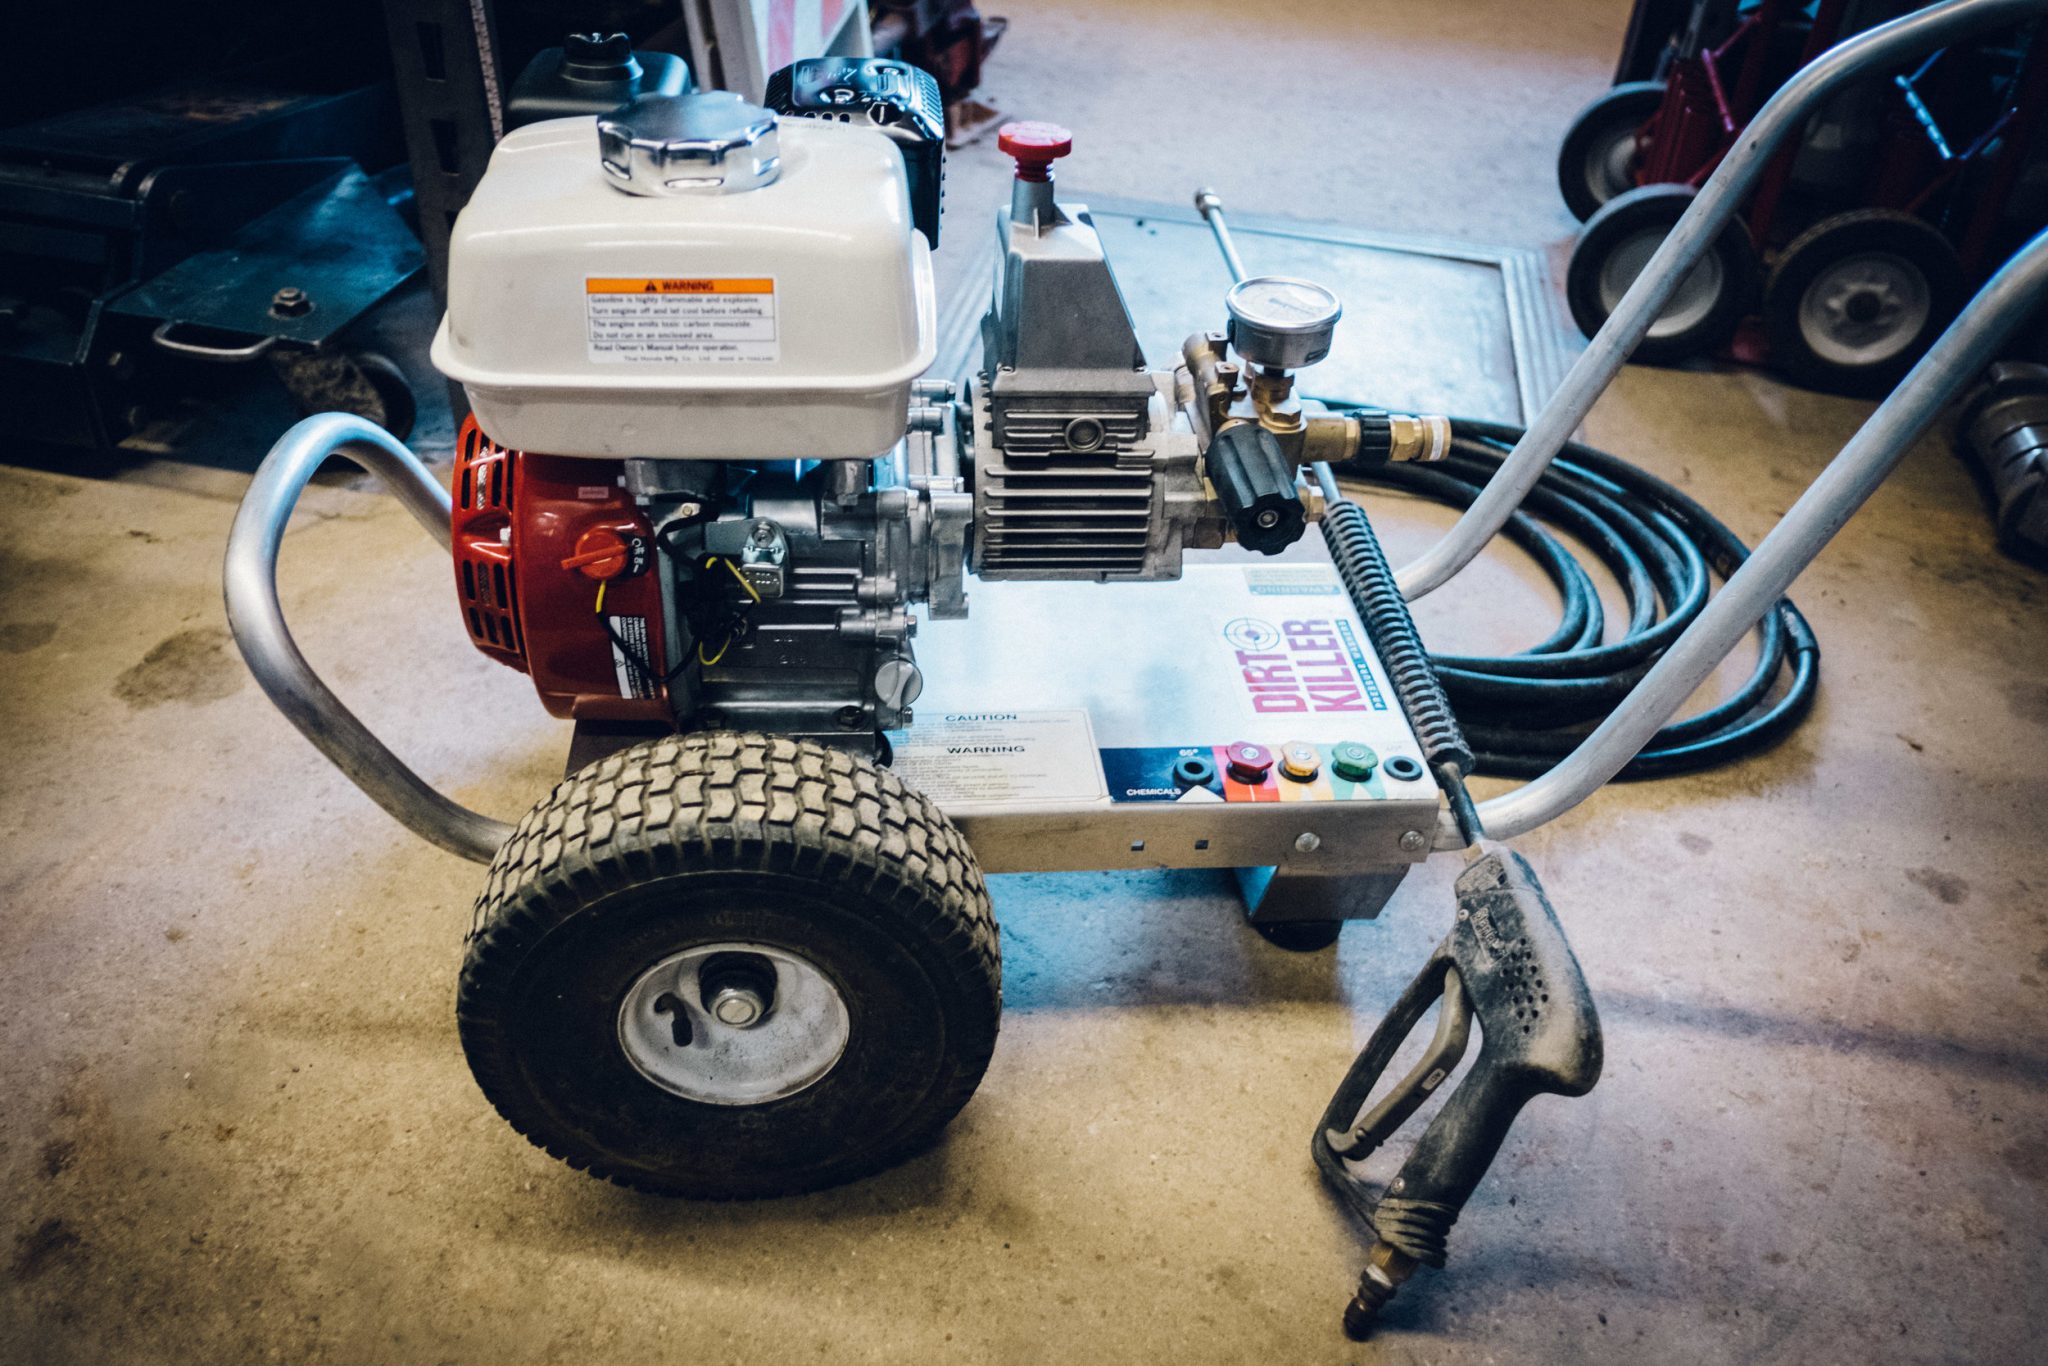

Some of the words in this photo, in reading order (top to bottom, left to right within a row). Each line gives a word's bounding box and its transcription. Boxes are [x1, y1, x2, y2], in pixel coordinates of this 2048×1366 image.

[662, 281, 714, 291] WARNING
[592, 306, 608, 314] Turn
[611, 307, 637, 316] engine
[640, 306, 650, 314] off
[653, 306, 668, 314] and
[670, 306, 680, 314] let
[682, 306, 698, 314] cool
[701, 306, 726, 314] before
[593, 320, 606, 328] The
[609, 321, 635, 330] engine
[638, 320, 658, 328] emits
[683, 320, 711, 328] carbon
[593, 331, 603, 339] Do
[606, 331, 618, 339] not
[636, 331, 644, 339] in
[658, 331, 693, 339] enclosed
[594, 343, 613, 351] Read
[647, 343, 673, 351] Manual
[676, 343, 699, 351] before
[1338, 620, 1361, 659] WASHERS
[1281, 620, 1367, 712] KILLER
[1235, 650, 1308, 713] DIRT
[1356, 663, 1383, 709] PRESSURE
[946, 745, 1025, 754] WARNING
[1126, 788, 1181, 796] CHEMICALS
